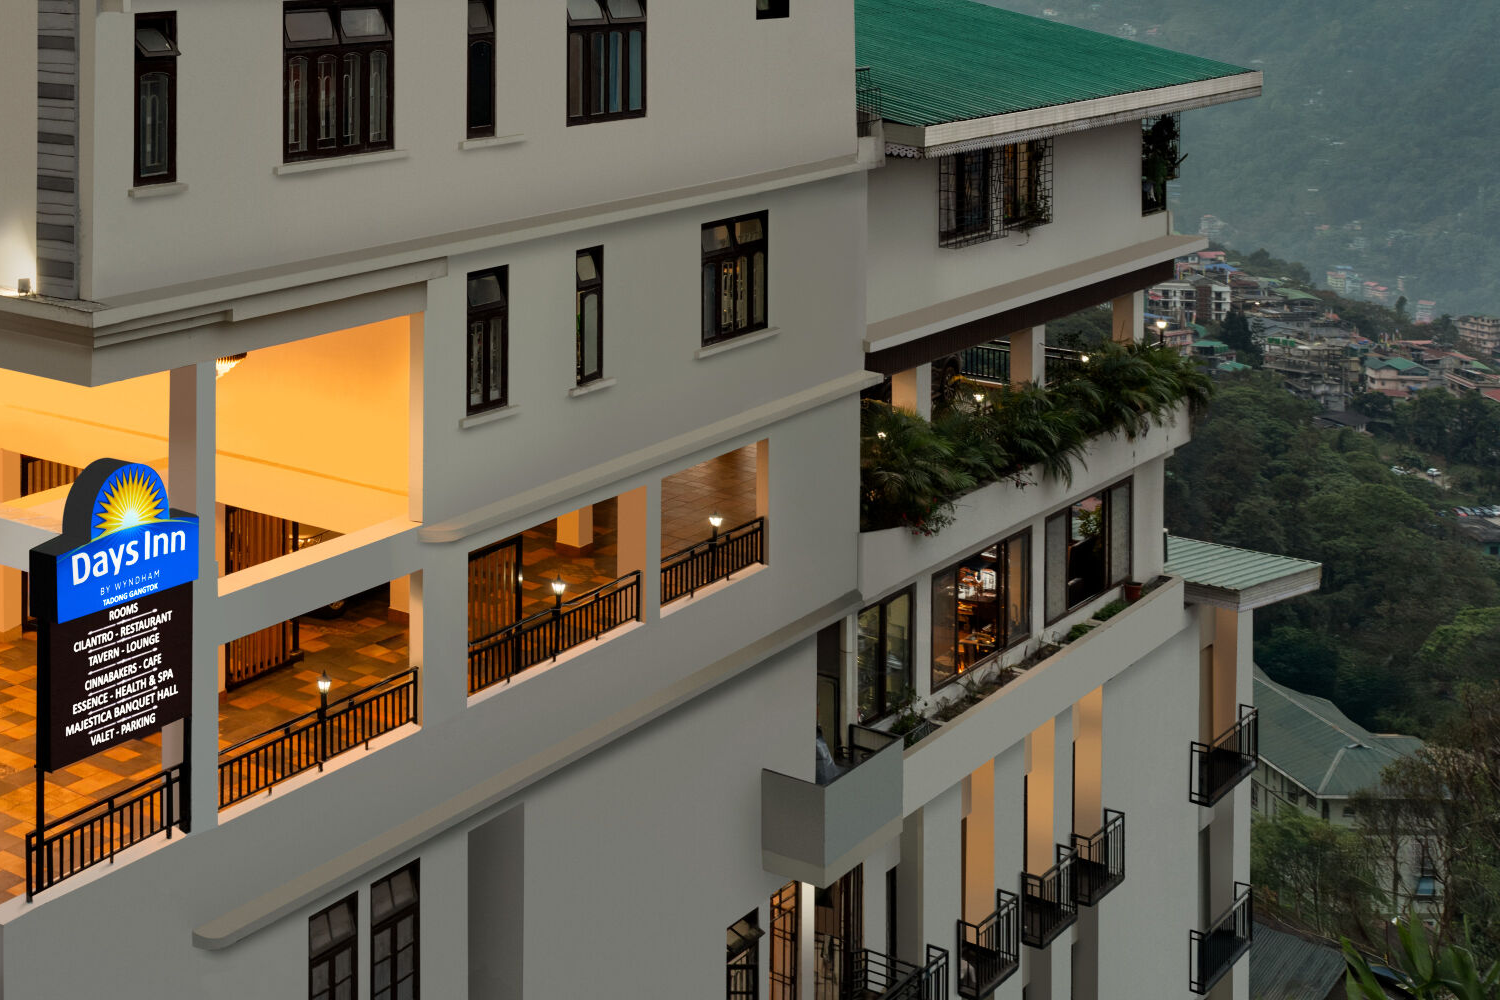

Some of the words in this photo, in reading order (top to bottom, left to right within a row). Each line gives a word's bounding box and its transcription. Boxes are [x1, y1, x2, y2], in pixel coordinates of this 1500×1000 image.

[71, 540, 139, 586] Days
[144, 530, 186, 560] Inn
[100, 585, 111, 596] BY
[114, 569, 160, 590] WYNDHAM
[102, 592, 128, 606] TADONG
[129, 583, 158, 598] GANGTOK
[108, 602, 139, 621] ROOMS
[73, 631, 114, 653] CILANTRO
[120, 610, 173, 637] RESTAURANT
[88, 647, 120, 667] TAVERN
[126, 632, 160, 654] LOUNGE
[84, 663, 137, 691] CINNABAKERS
[143, 653, 162, 669] CAFE
[72, 692, 109, 715] ESSENCE
[115, 678, 147, 699] HEALTH
[148, 674, 156, 686] &
[157, 668, 174, 683] SPA
[65, 710, 112, 737] MAJESTICA
[113, 693, 155, 718] BANQUET
[157, 684, 179, 701] HALL
[90, 728, 115, 746] VALET
[121, 713, 156, 736] PARKING
